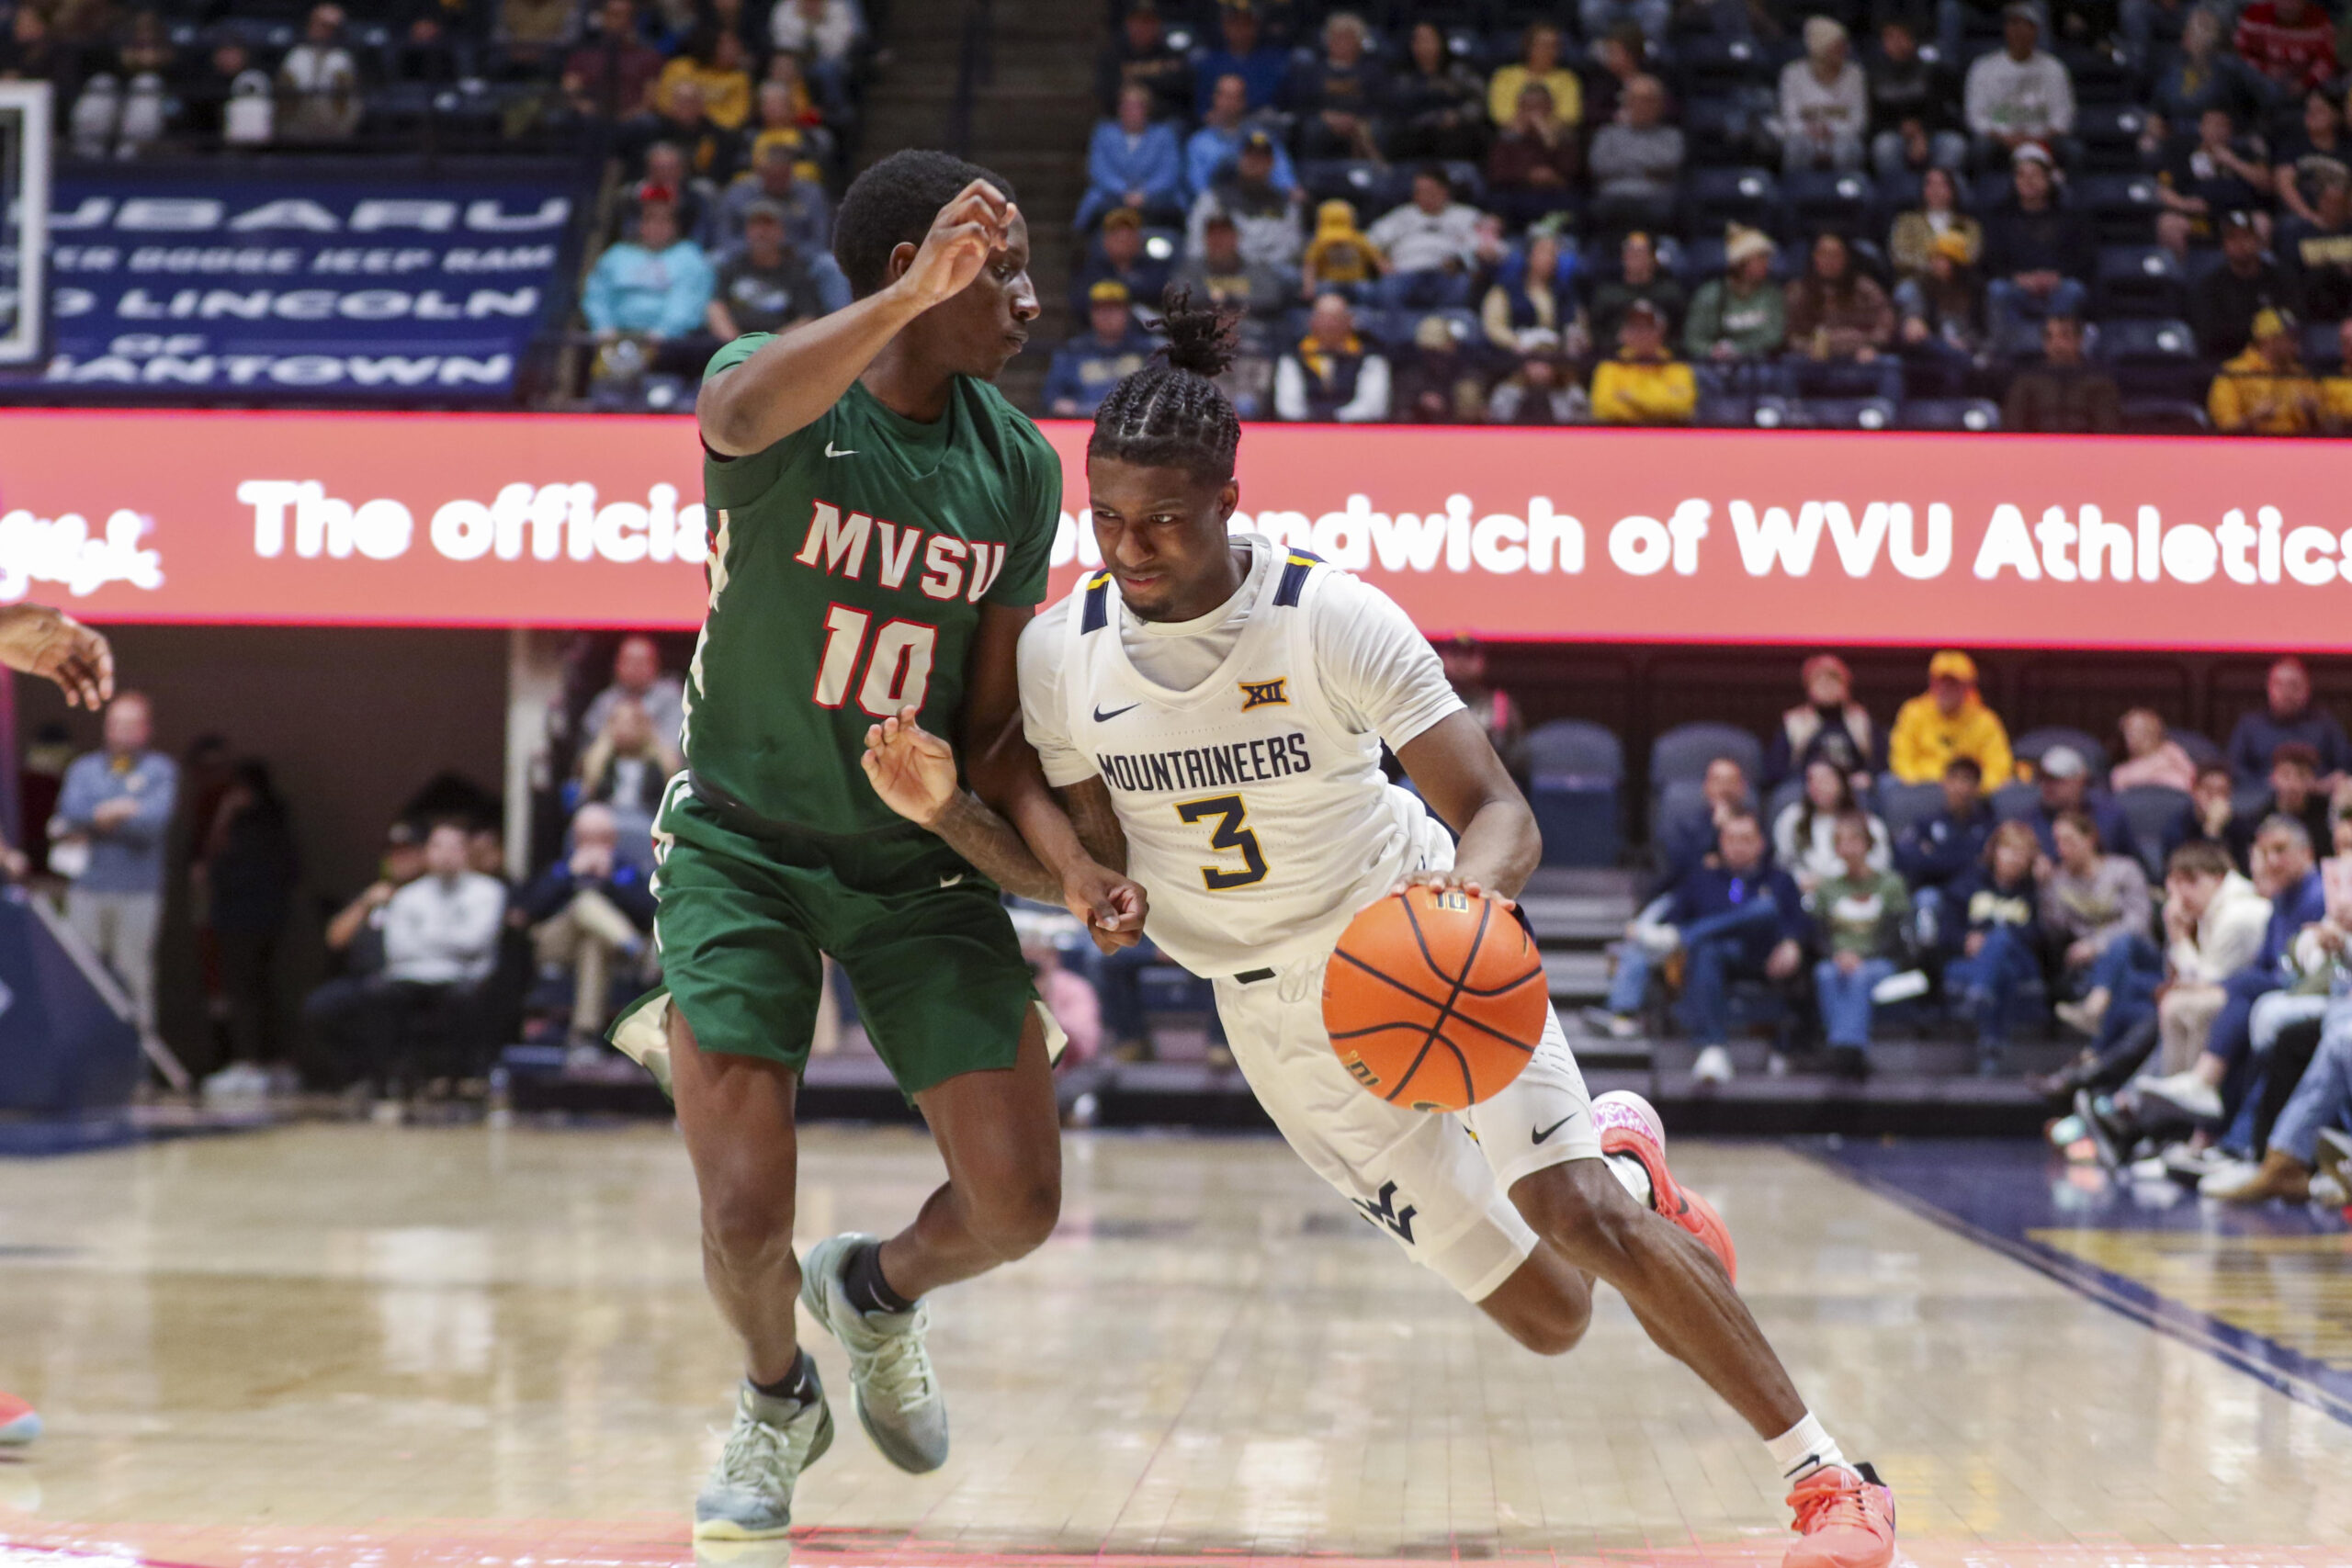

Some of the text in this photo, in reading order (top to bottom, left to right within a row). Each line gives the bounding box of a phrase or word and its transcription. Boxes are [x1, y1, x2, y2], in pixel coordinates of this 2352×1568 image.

[128, 246, 302, 275] DODGE
[312, 246, 433, 275] JEEP
[442, 243, 557, 273] RAM
[107, 333, 209, 358] OF
[116, 286, 539, 321] LINCOLN
[237, 479, 413, 558] The
[430, 482, 709, 563] officia
[793, 499, 1006, 604] MVSU
[1228, 493, 1585, 576] ndwich
[1608, 498, 1711, 576] of
[1728, 499, 1952, 580] WVU
[812, 601, 938, 719] 10
[1097, 732, 1311, 792] MOUNTAINEERS
[1175, 793, 1270, 891] 3
